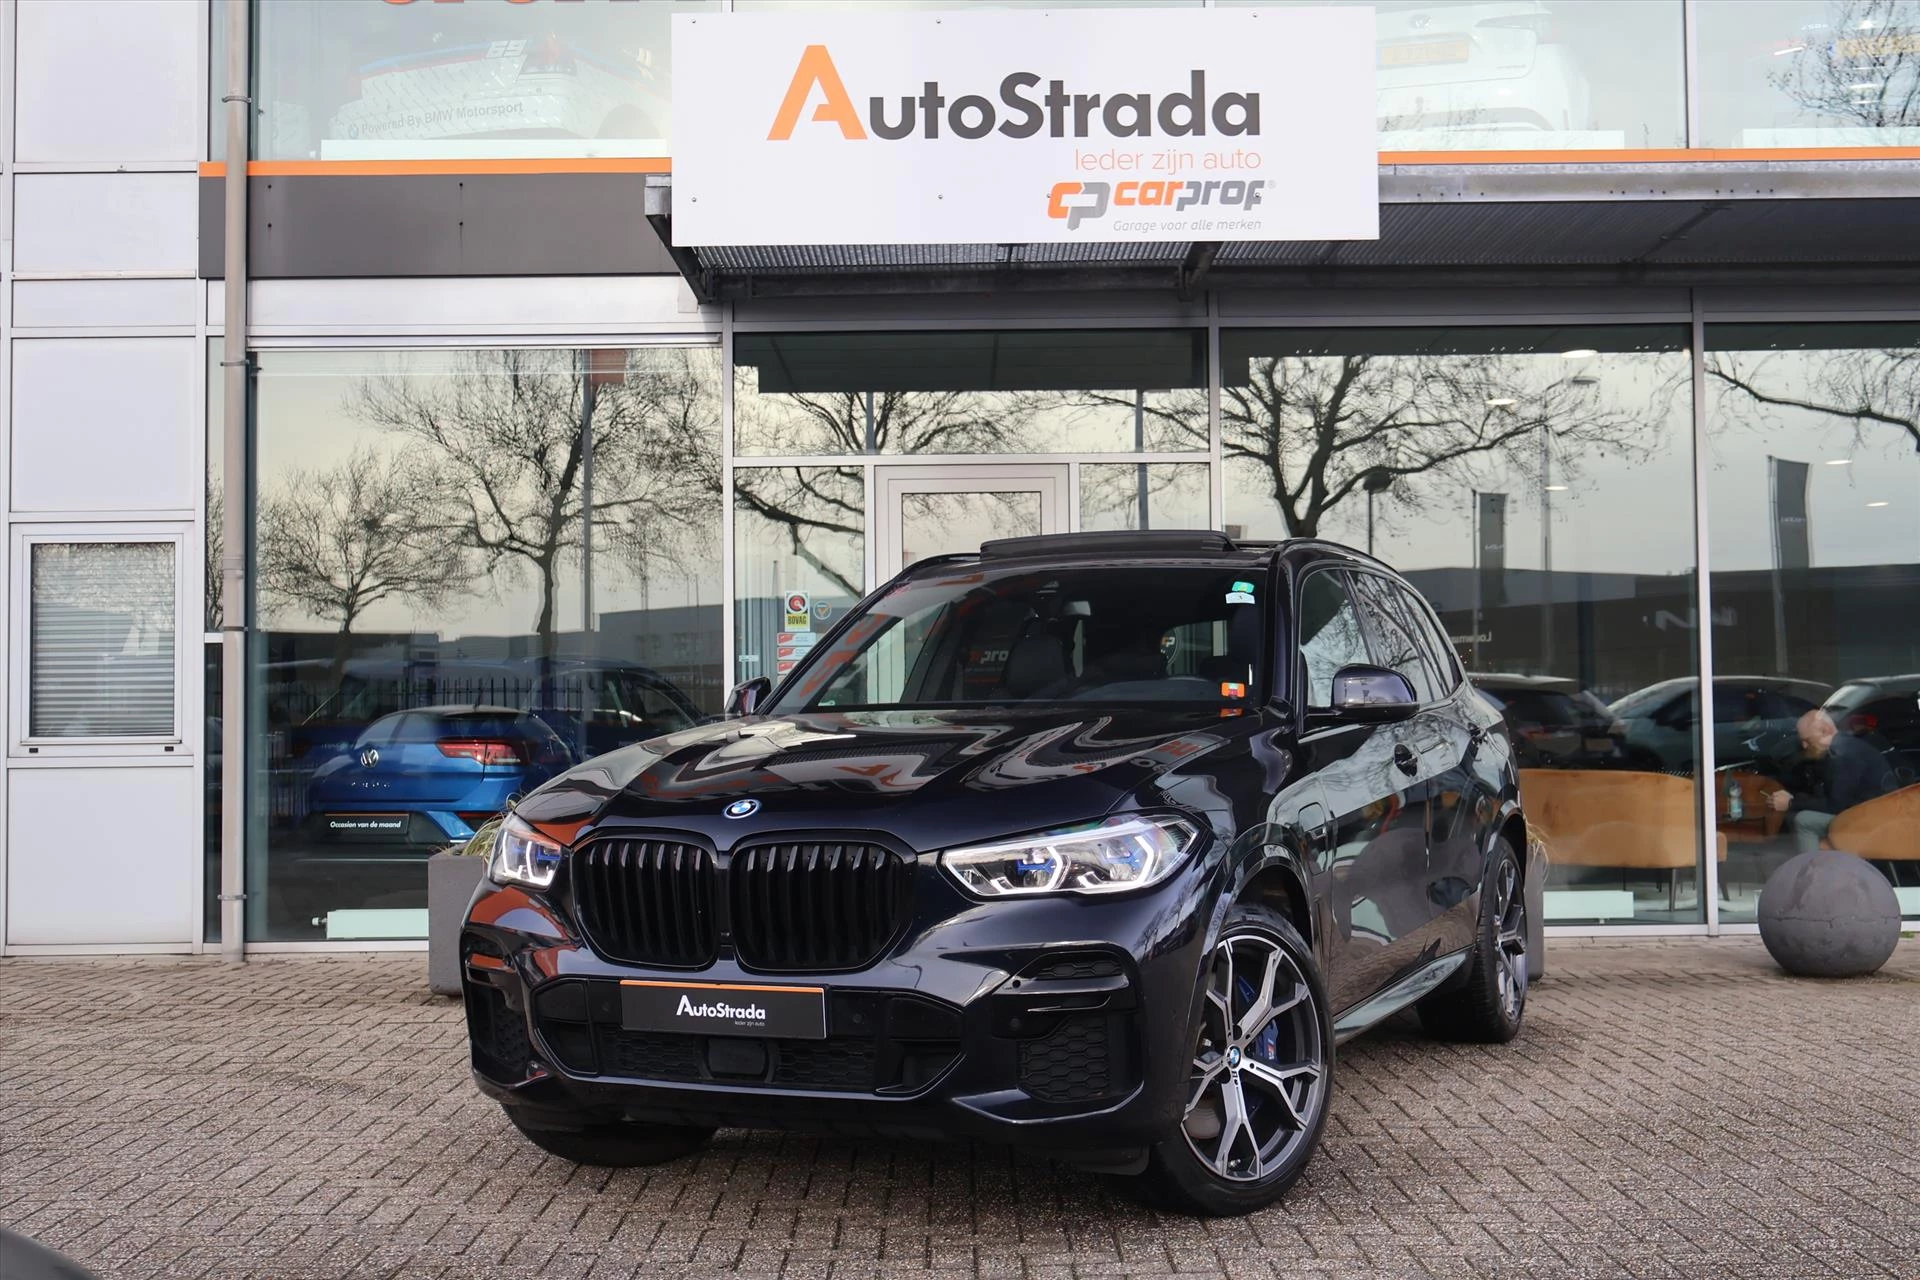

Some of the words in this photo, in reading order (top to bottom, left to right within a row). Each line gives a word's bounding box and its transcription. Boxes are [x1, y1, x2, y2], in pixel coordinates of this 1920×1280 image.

[766, 45, 1260, 140] AutoStrada
[361, 117, 404, 134] Powered
[406, 115, 423, 129] By
[424, 108, 454, 124] BMW
[456, 102, 524, 120] Motorsport
[1074, 149, 1144, 170] Ieder
[1151, 149, 1194, 175] zijn
[1203, 149, 1261, 170] auto
[1113, 220, 1156, 233] Garage
[1160, 221, 1187, 231] voor
[1191, 219, 1212, 231] alle
[1216, 219, 1262, 231] merken
[787, 615, 807, 625] BOVAG
[676, 994, 766, 1020] AutoStrada
